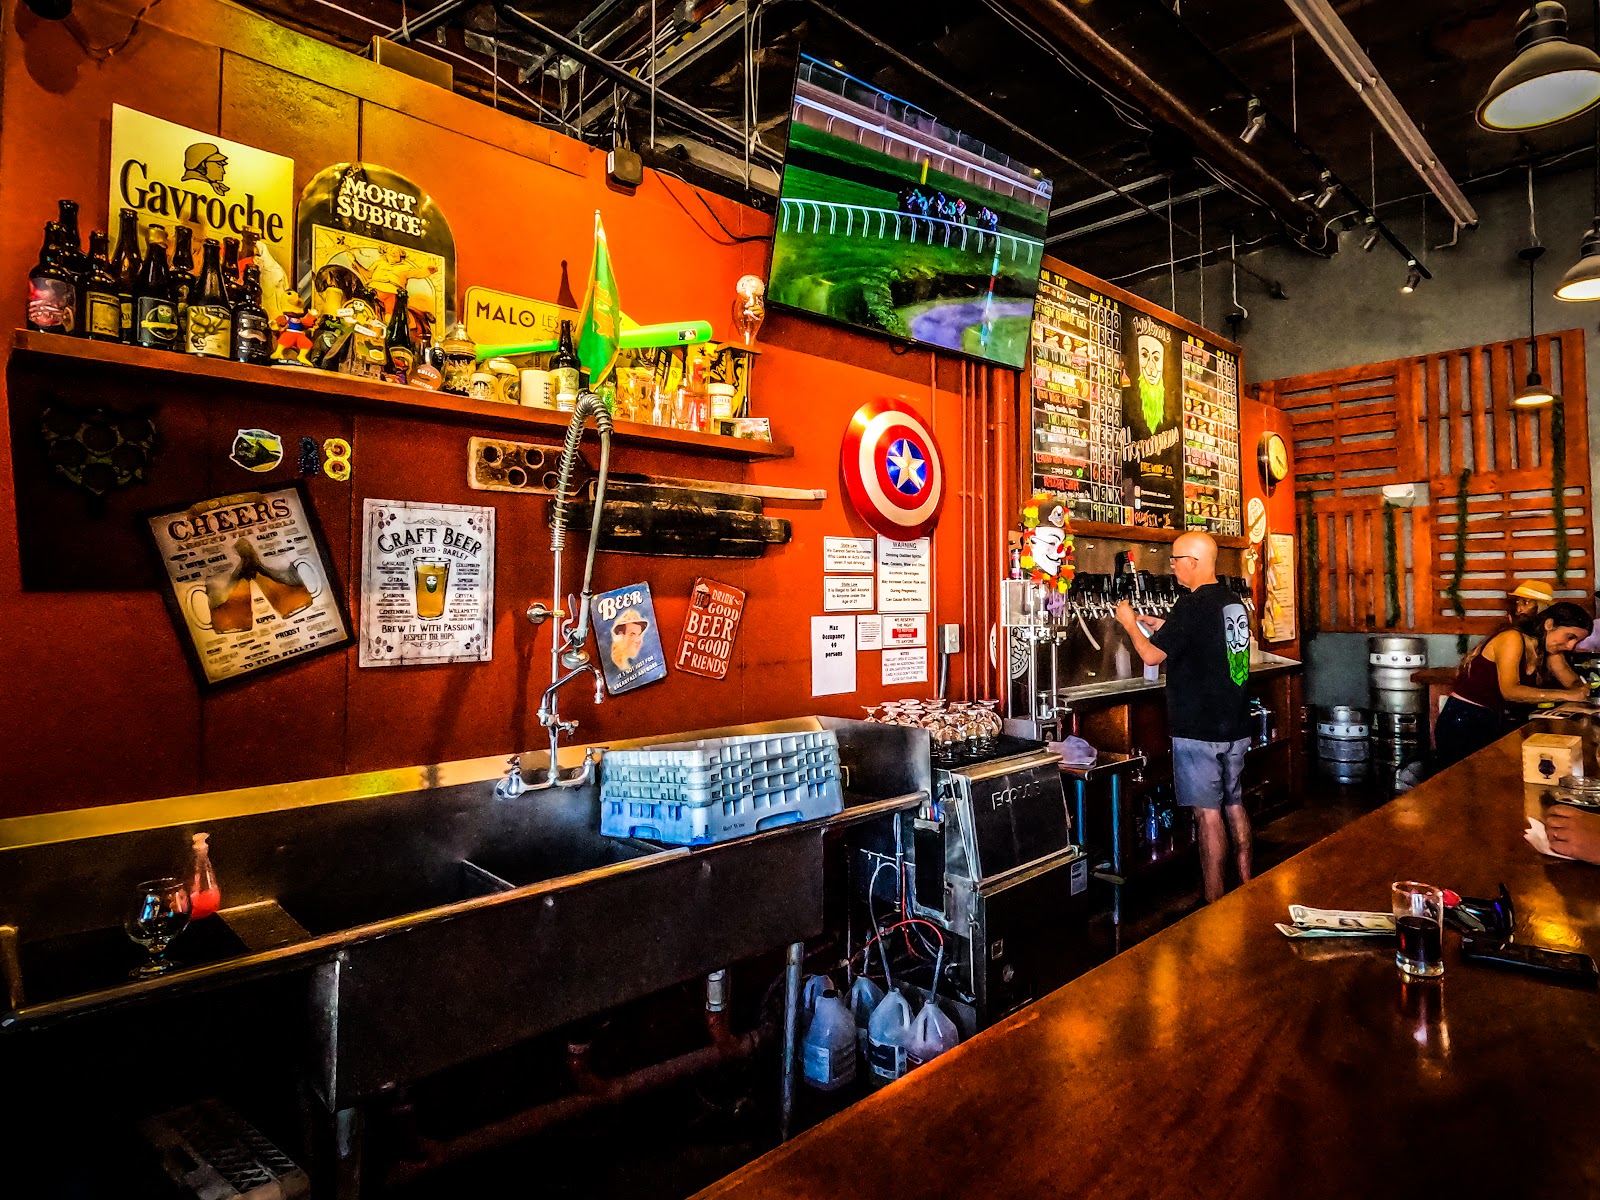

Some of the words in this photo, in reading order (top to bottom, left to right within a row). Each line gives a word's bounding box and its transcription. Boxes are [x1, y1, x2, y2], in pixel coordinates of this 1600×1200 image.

[119, 159, 284, 243] Gavroche
[343, 175, 417, 214] MORT
[337, 195, 421, 237] SUBITE
[1054, 275, 1068, 289] TAP
[476, 301, 535, 328] MALO
[168, 499, 292, 541] CHEERS
[377, 528, 438, 554] CRAFT
[443, 527, 482, 558] BEER
[396, 548, 415, 558] HOPS
[443, 548, 469, 561] BARLEY
[598, 590, 643, 621] BEER
[712, 589, 735, 605] DRINK
[708, 602, 739, 621] GOOD
[382, 624, 406, 633] BREW
[408, 624, 416, 632] IT
[420, 623, 441, 632] WITH
[443, 623, 475, 632] PASSION!
[686, 610, 734, 641] BEER
[679, 641, 727, 674] FRIENDS
[697, 638, 730, 659] GOOD
[626, 666, 635, 674] NOT
[645, 655, 654, 664] FOR
[613, 673, 638, 690] BREAKFAST
